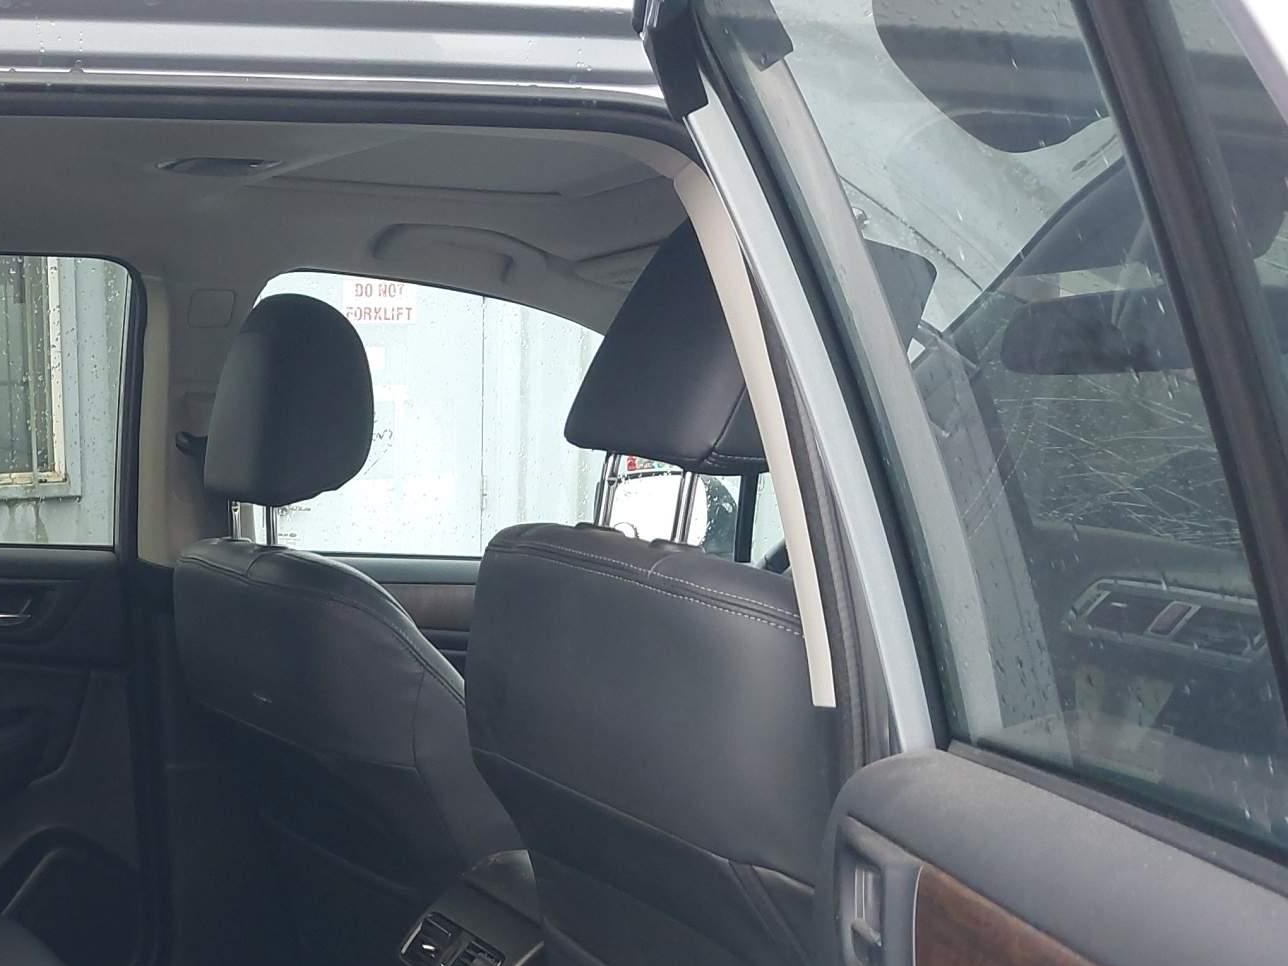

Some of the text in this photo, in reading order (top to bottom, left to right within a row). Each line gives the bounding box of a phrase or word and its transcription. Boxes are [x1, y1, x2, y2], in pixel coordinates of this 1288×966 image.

[355, 283, 406, 298] DO NOT
[346, 306, 413, 321] FORKLIFT
